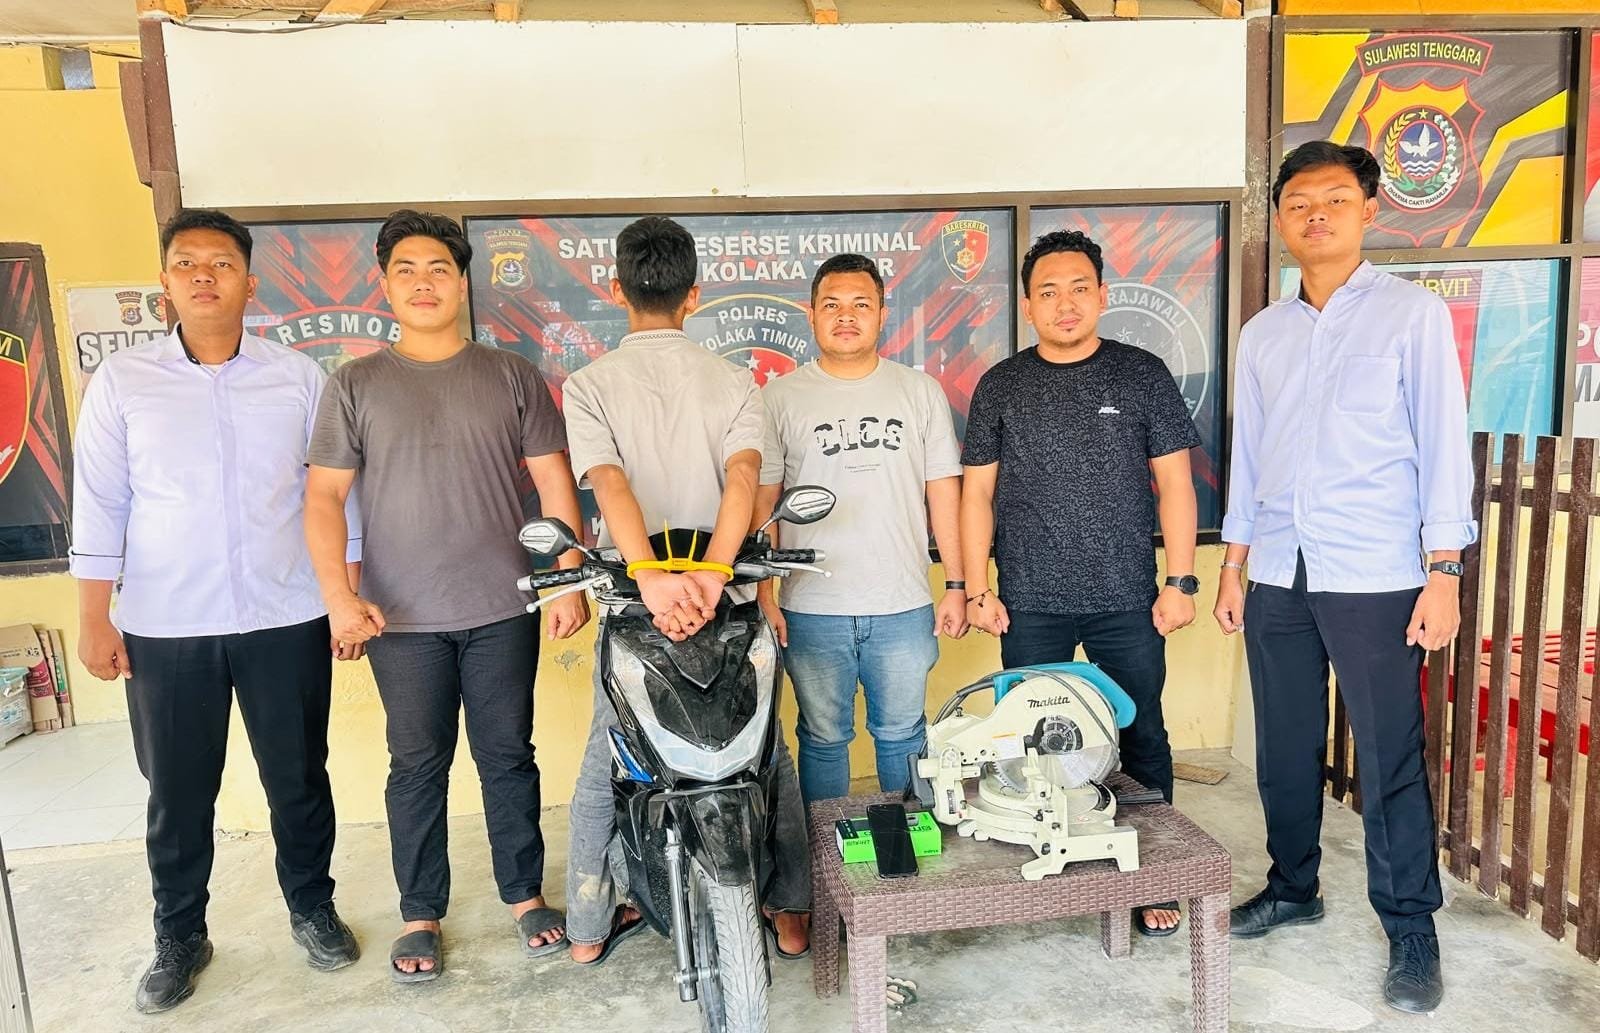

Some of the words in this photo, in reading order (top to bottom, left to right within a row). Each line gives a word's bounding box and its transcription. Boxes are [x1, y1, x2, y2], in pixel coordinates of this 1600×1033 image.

[1364, 42, 1420, 66] SULAWESI
[1423, 42, 1481, 66] TENGGARA
[694, 235, 791, 257] ESERSE
[800, 231, 921, 254] KRIMINAL
[701, 258, 807, 282] KOLAKA
[718, 305, 788, 325] POLRES
[1107, 288, 1188, 328] RAJAWALI
[276, 313, 402, 346] RESMOB
[700, 327, 757, 352] OLAKA
[761, 327, 808, 354] TIMUR
